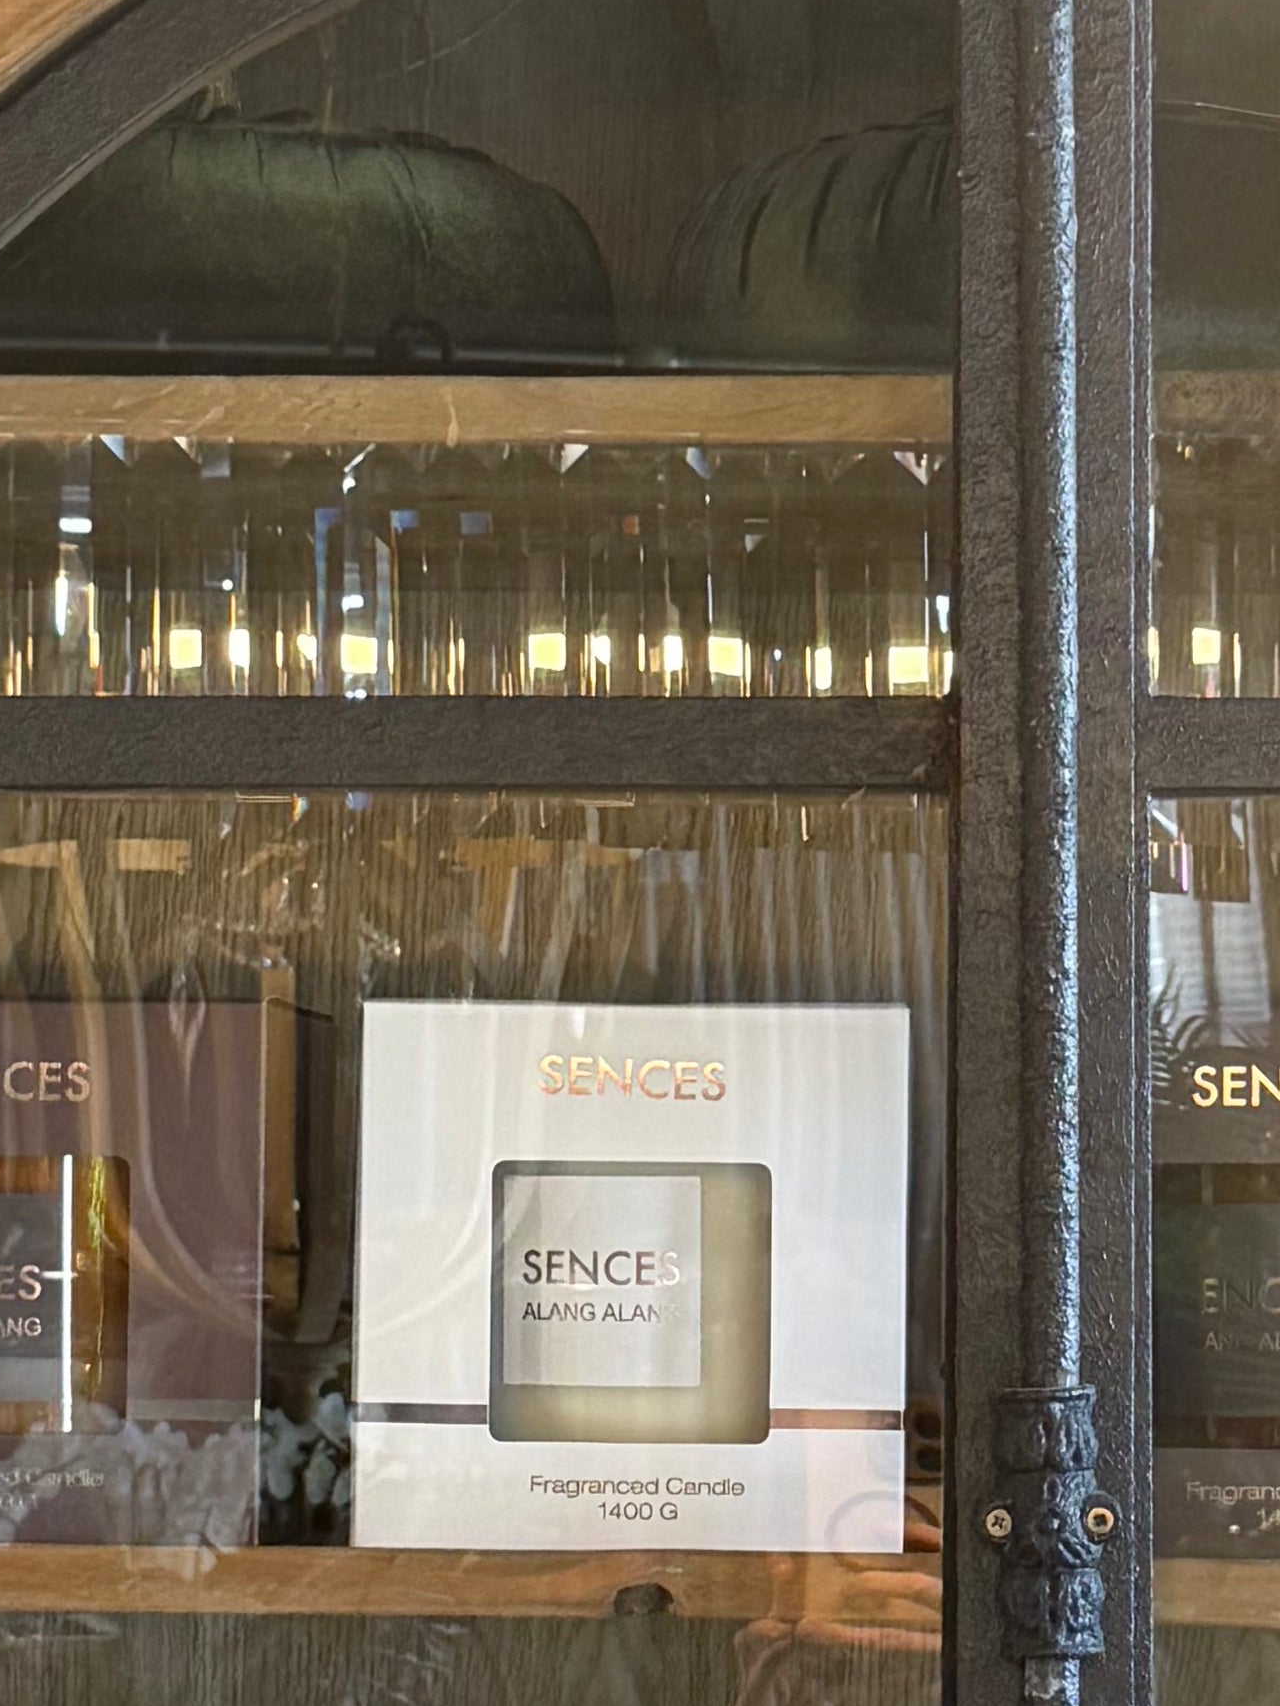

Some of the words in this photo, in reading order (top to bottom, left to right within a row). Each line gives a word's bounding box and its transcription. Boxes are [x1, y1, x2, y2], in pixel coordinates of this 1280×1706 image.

[538, 1054, 727, 1102] SENCES
[522, 1248, 681, 1287] SENCES
[522, 1302, 596, 1322] ALANG
[530, 1475, 660, 1499] Fragranced
[665, 1477, 746, 1497] Candle
[597, 1501, 654, 1521] 1400
[659, 1501, 679, 1521] G
